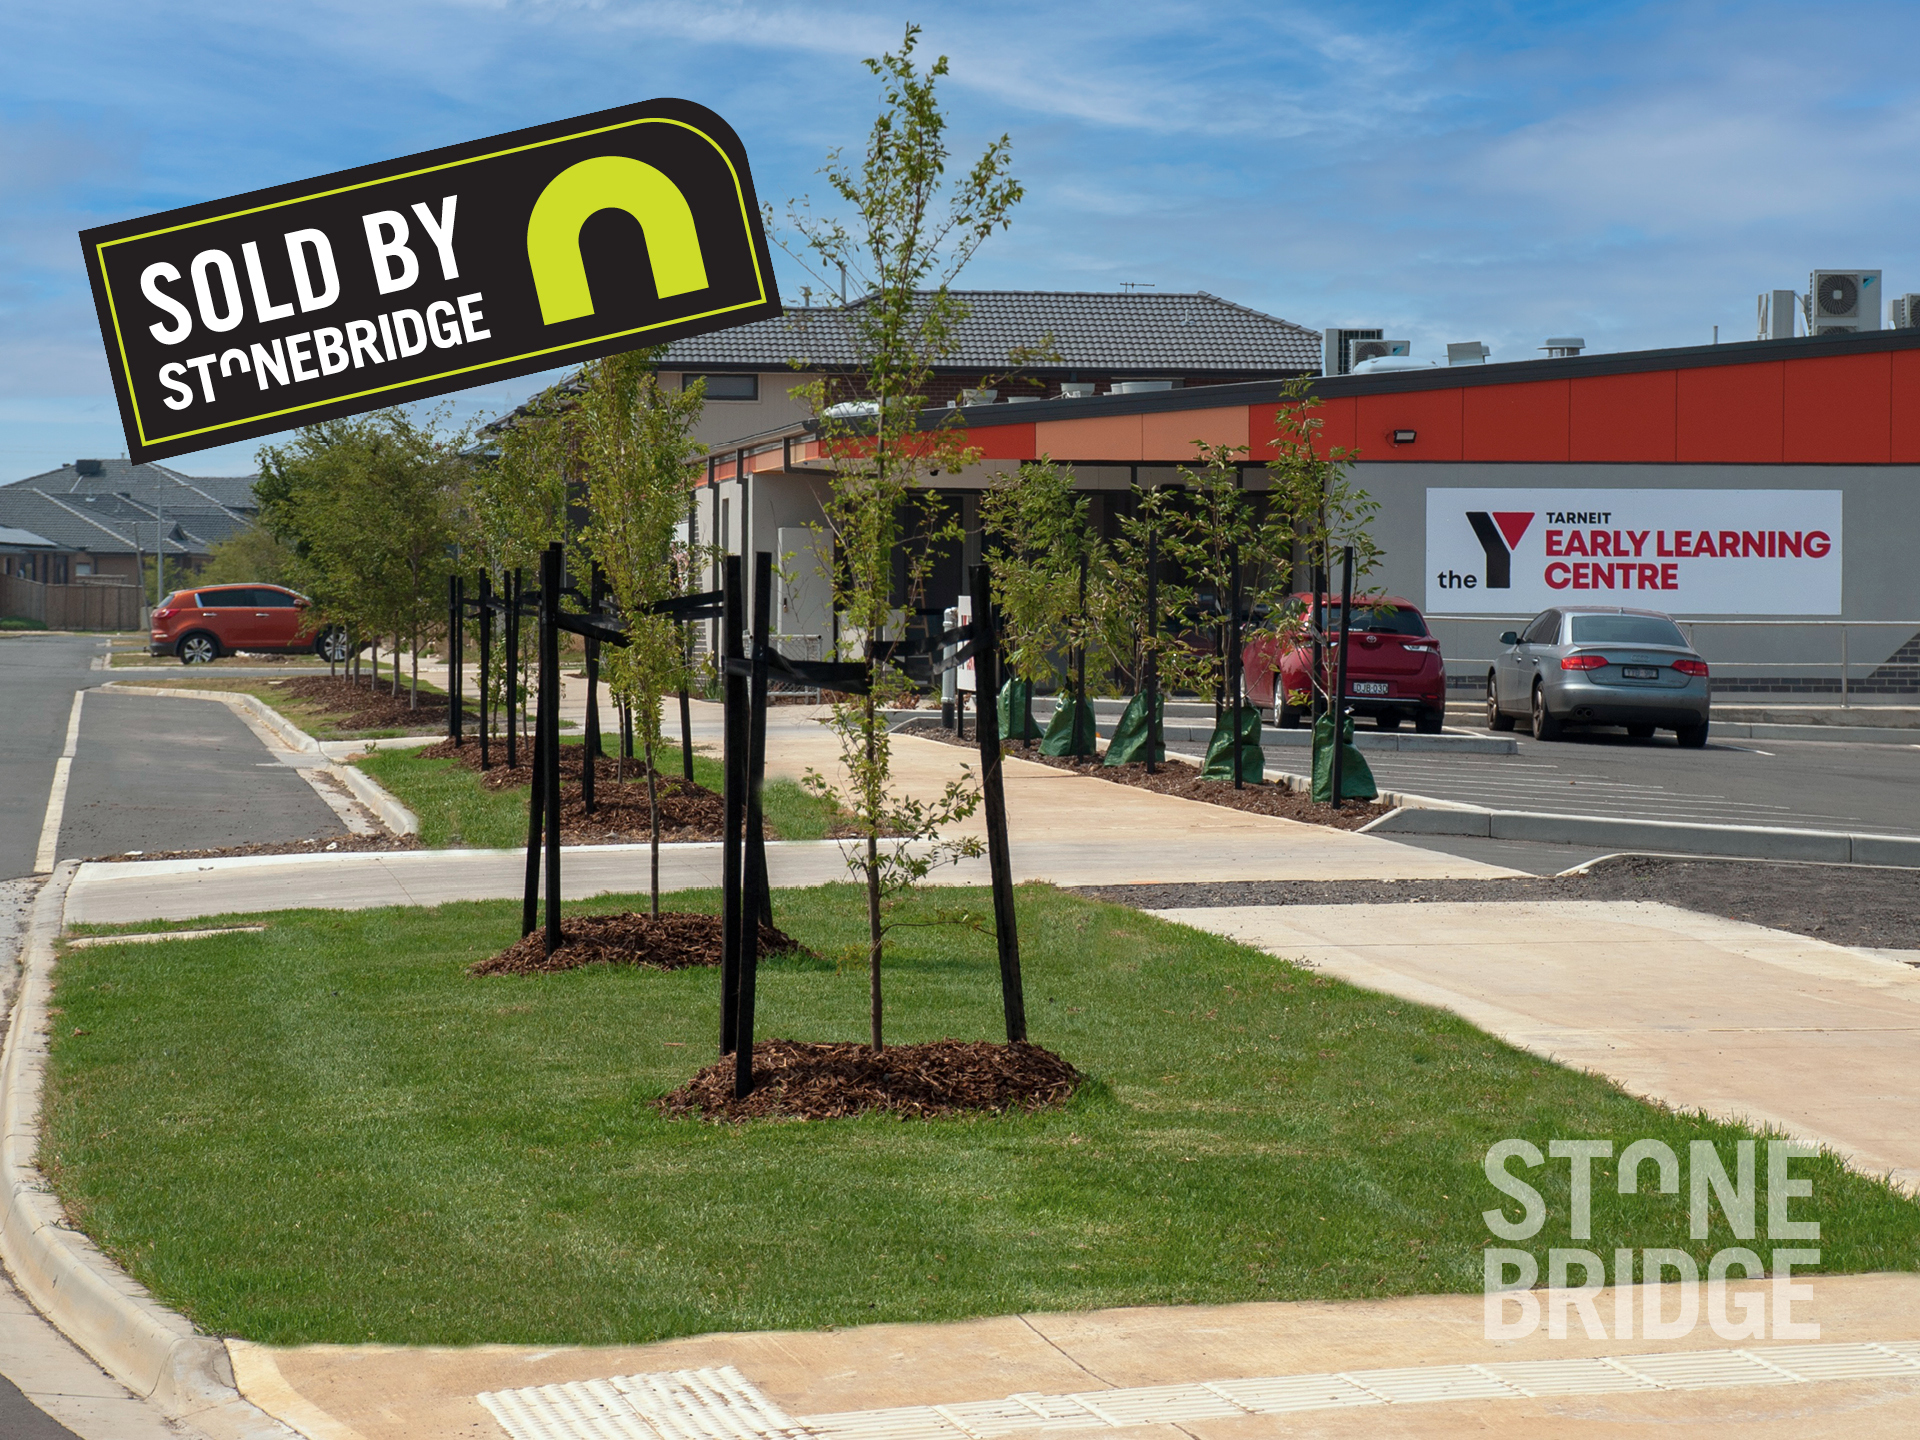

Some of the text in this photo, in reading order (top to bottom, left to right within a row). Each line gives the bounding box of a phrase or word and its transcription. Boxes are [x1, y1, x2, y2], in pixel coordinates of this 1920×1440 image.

[1546, 511, 1612, 524] TARNEIT
[1437, 511, 1536, 589] the Y
[1545, 530, 1832, 558] EARLY LEARNING
[1544, 562, 1679, 590] CENTRE
